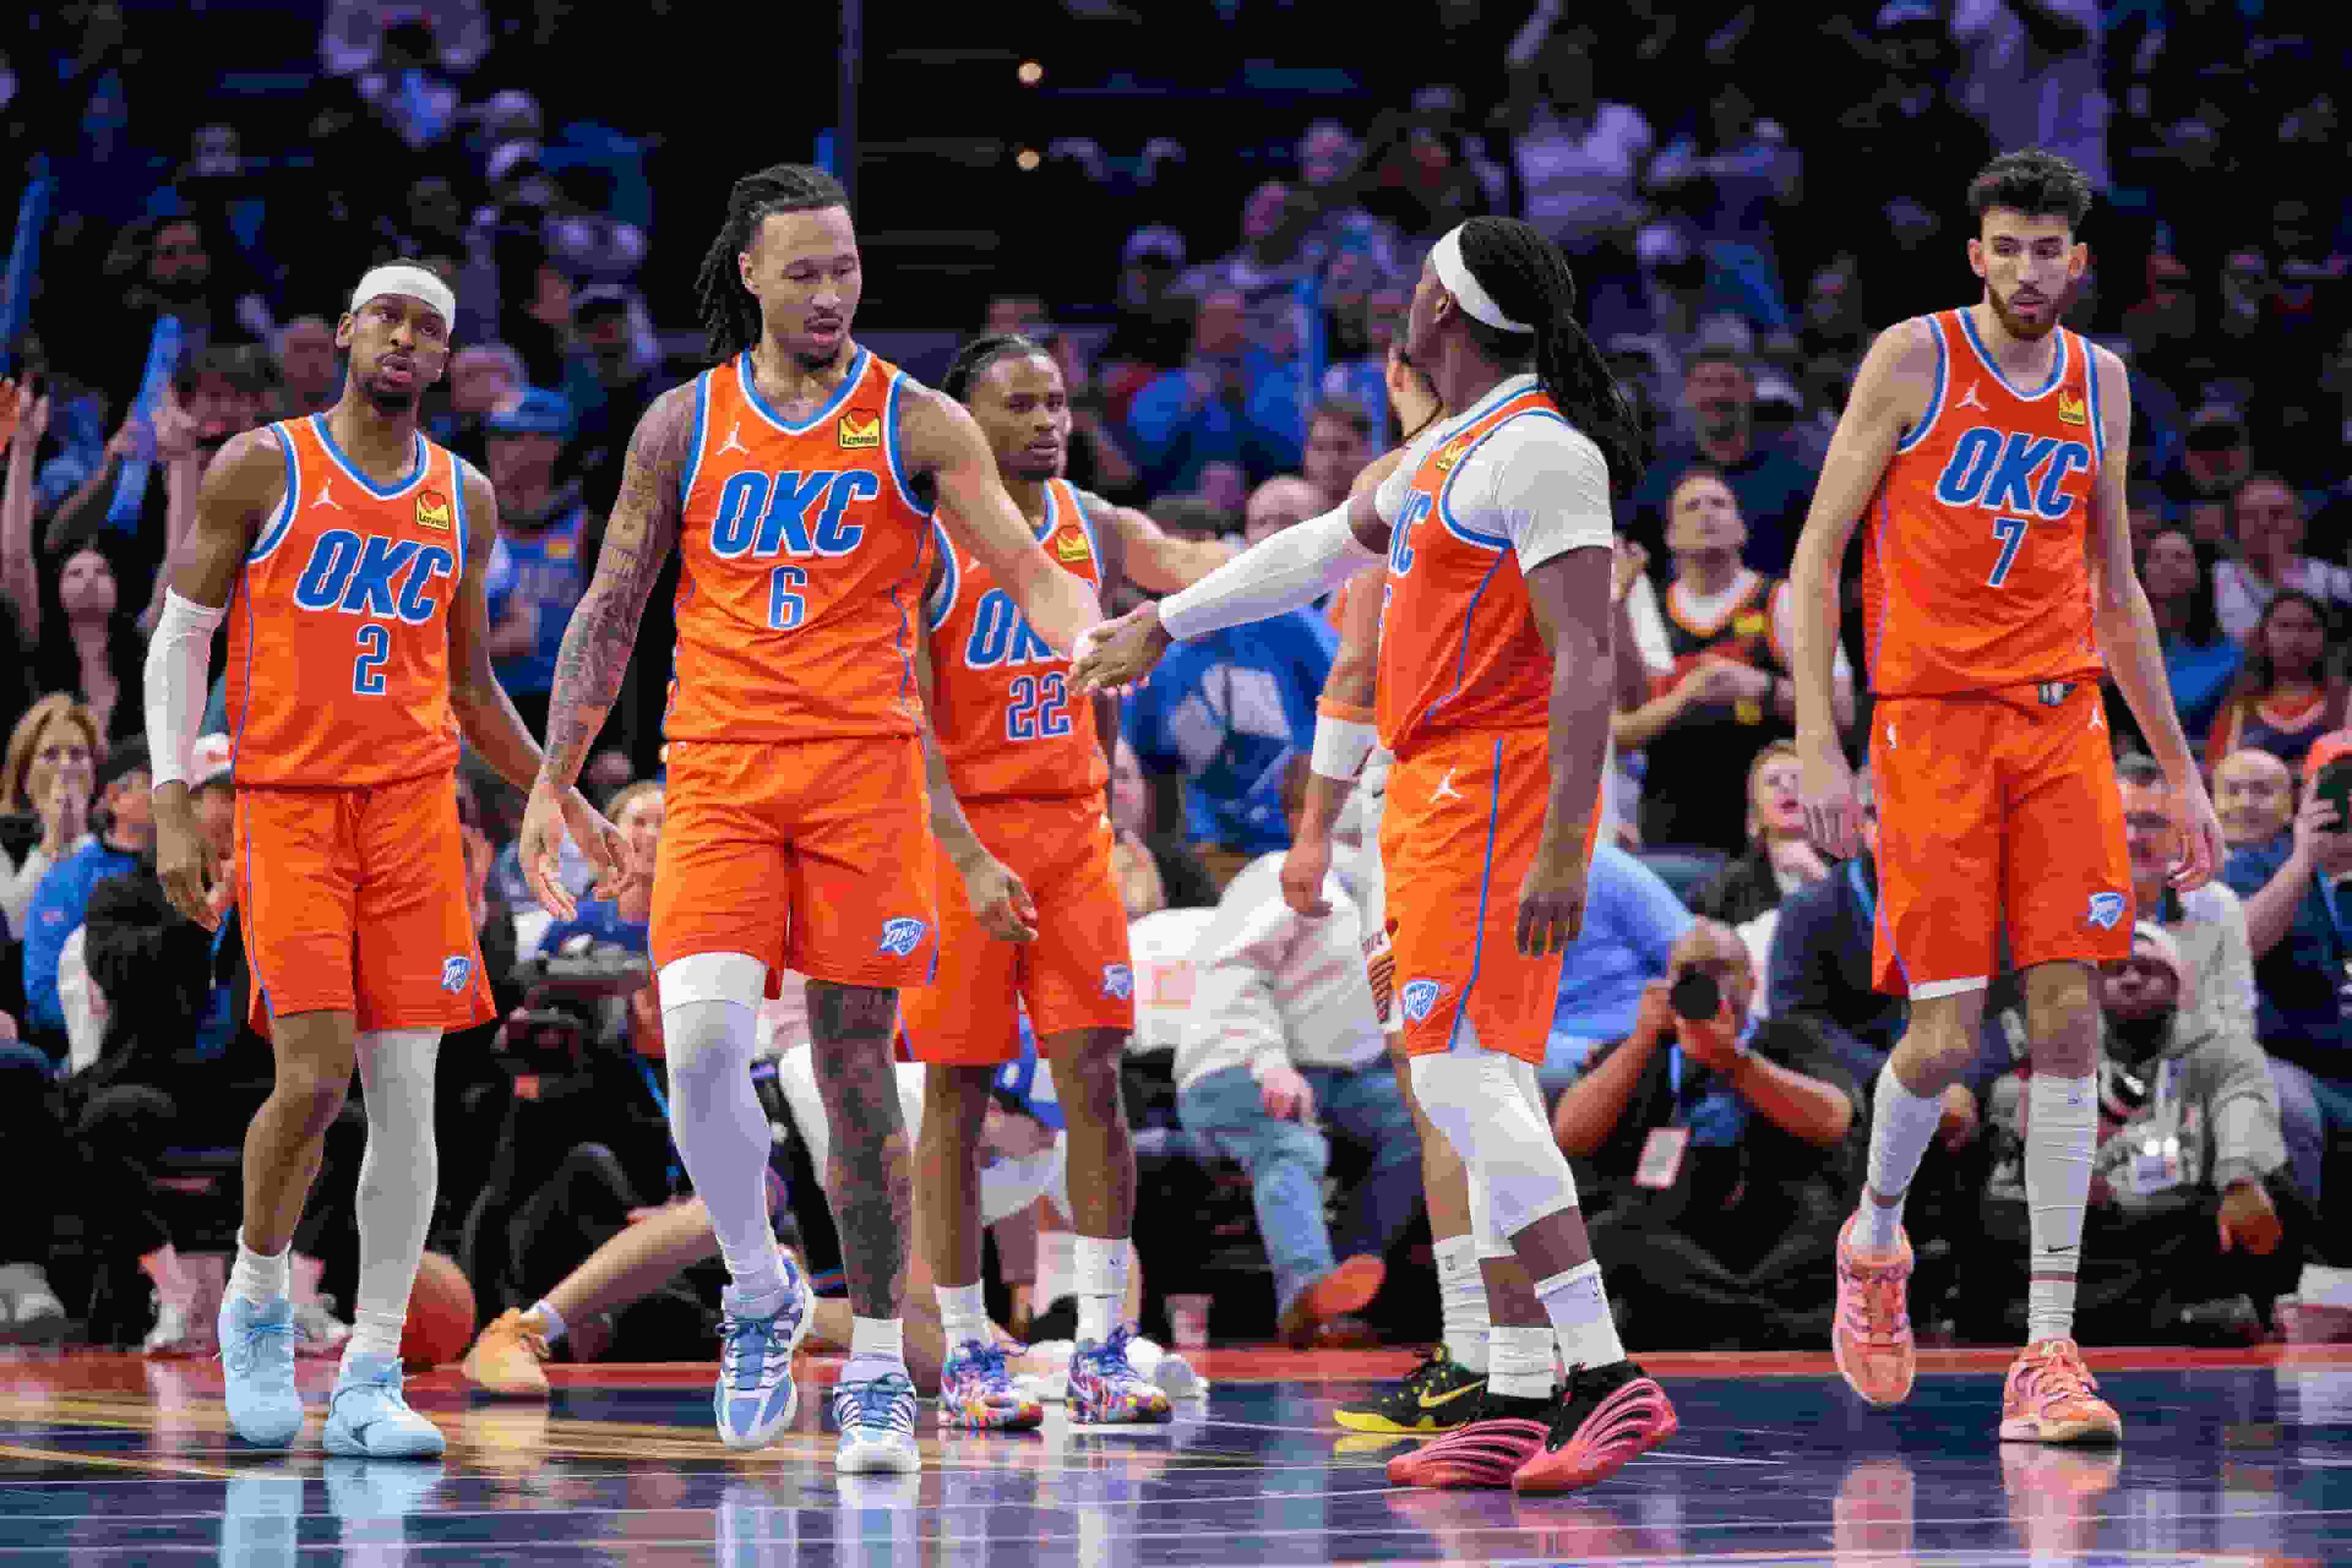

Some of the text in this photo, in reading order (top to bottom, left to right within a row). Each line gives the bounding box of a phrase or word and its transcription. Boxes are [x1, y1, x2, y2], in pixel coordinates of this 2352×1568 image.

[1936, 426, 2090, 519] OKC
[710, 470, 880, 558] OKC
[294, 529, 454, 625] OKC
[1988, 516, 2029, 587] 7
[767, 565, 808, 630] 6
[353, 622, 391, 695] 2
[1005, 671, 1073, 741] 22
